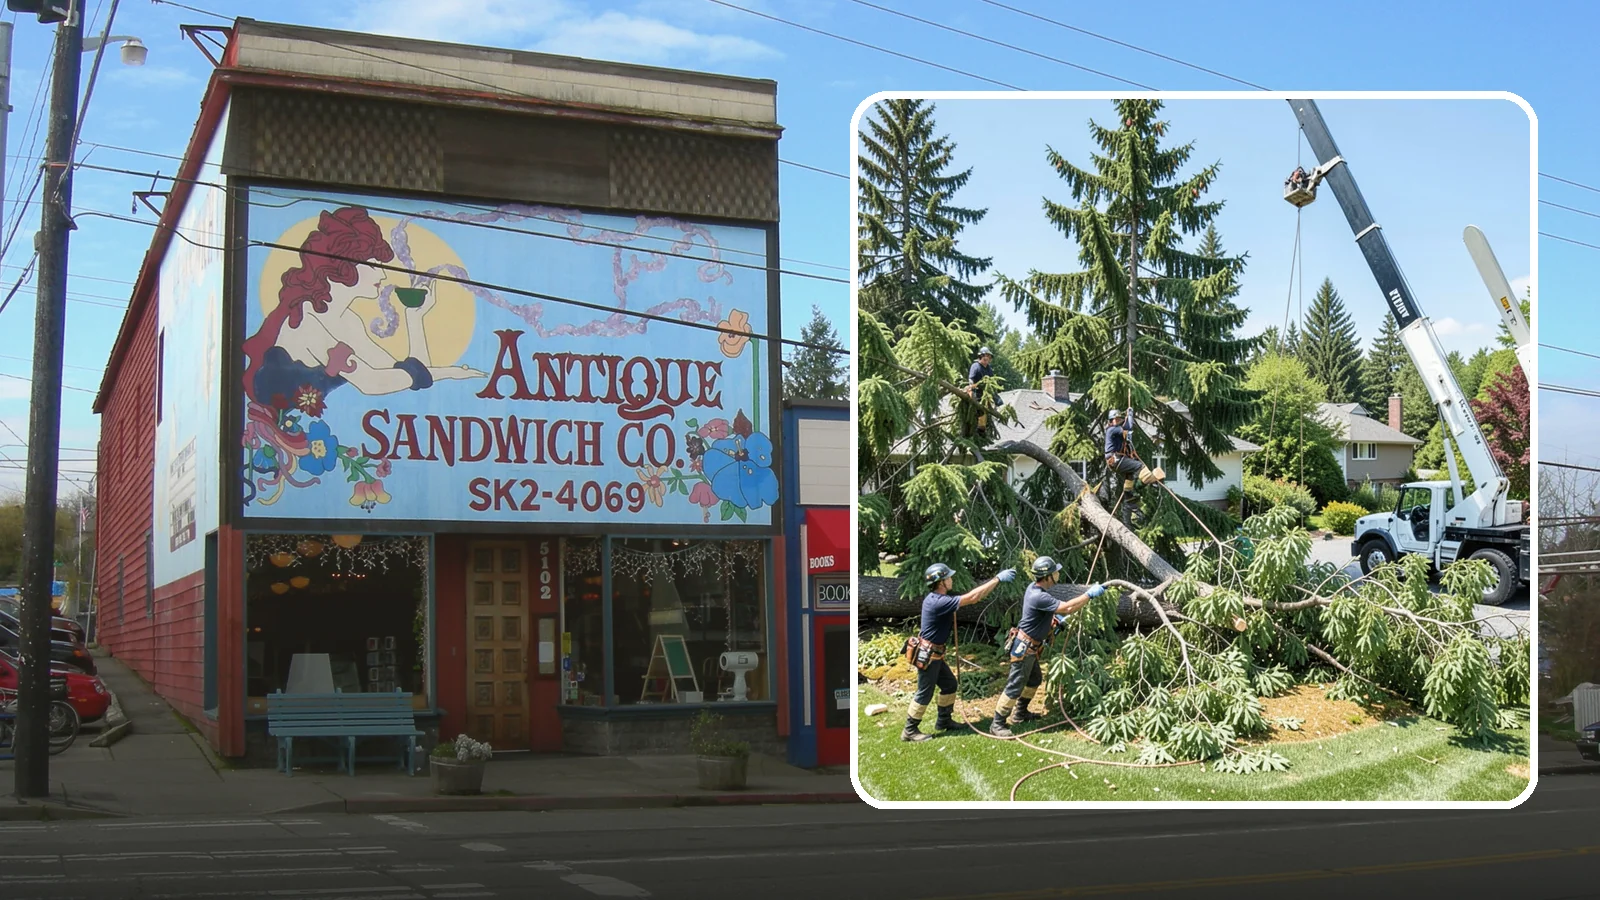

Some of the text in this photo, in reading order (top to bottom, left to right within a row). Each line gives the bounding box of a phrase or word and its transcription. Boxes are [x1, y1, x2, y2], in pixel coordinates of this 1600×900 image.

[361, 408, 686, 469] SANDWICH CO.
[468, 476, 646, 513] SK2-4069
[540, 541, 551, 600] 5102
[809, 555, 835, 569] BOOKS
